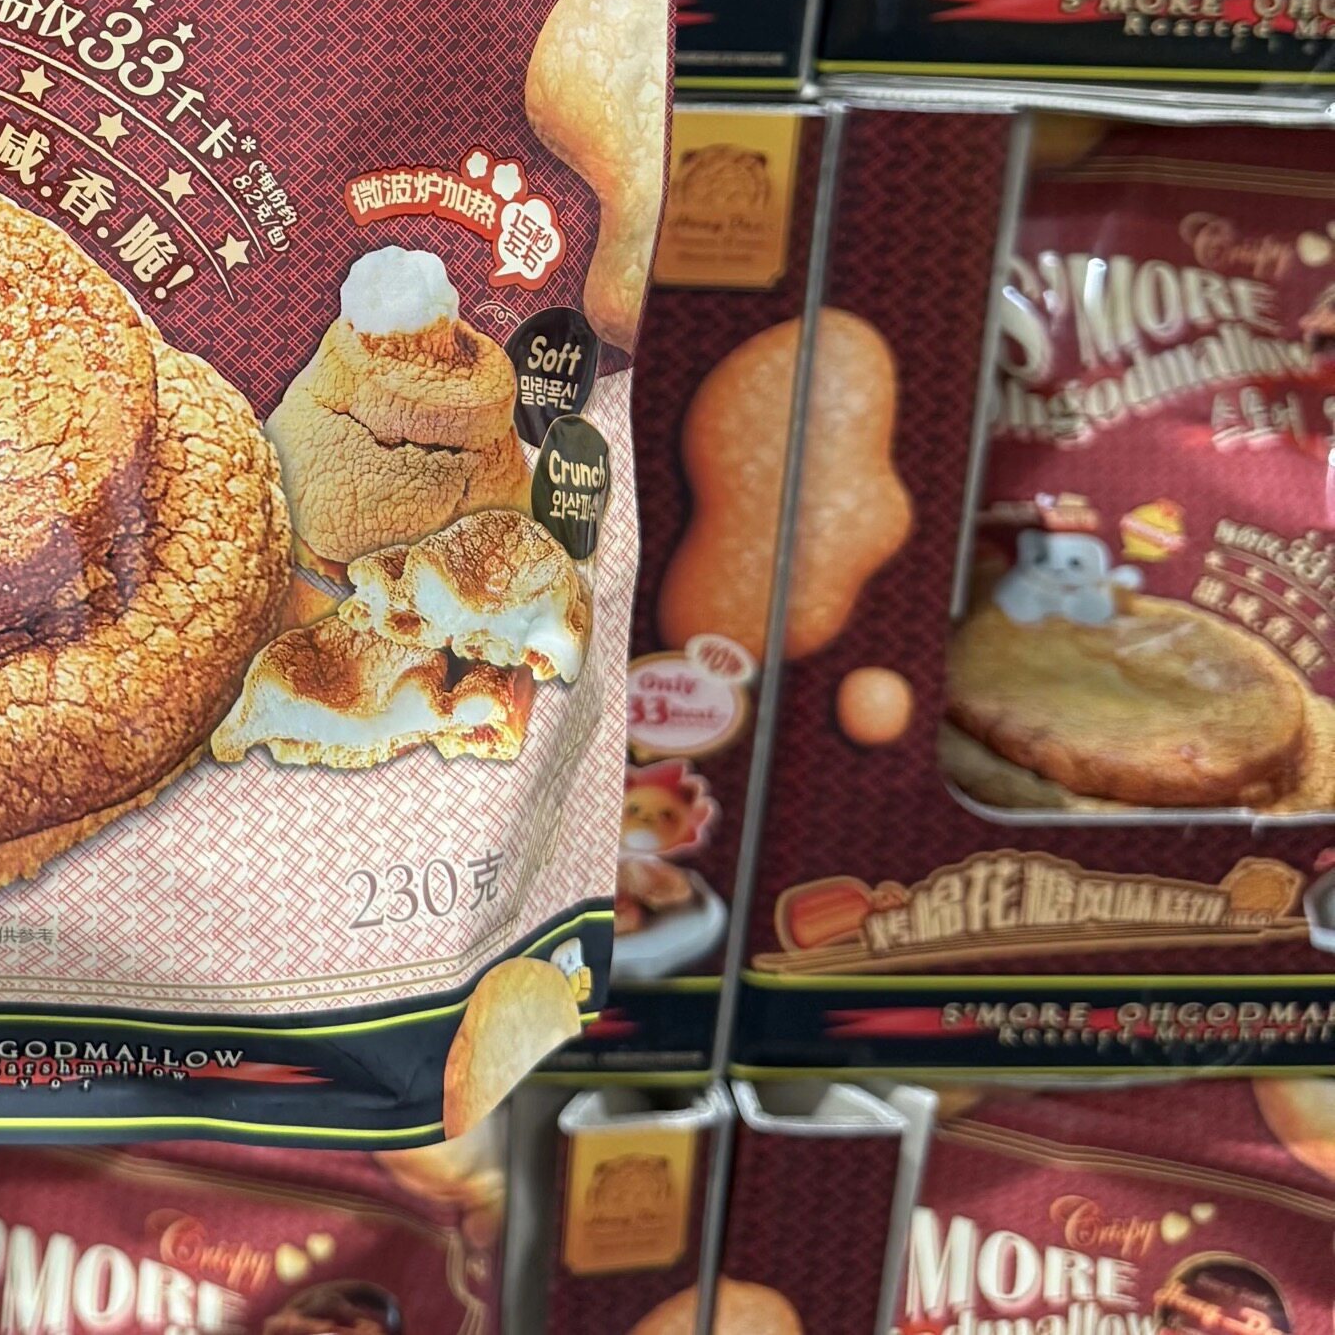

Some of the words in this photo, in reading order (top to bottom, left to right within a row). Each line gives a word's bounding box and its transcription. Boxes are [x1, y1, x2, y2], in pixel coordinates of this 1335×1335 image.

[350, 170, 497, 230] 微波炉加热
[503, 228, 543, 273] 左右
[511, 209, 554, 254] 15秒
[527, 335, 582, 377] Soft
[520, 375, 579, 411] 말랑폭신
[548, 449, 606, 489] Crunch
[940, 1001, 1090, 1027] S'MORE
